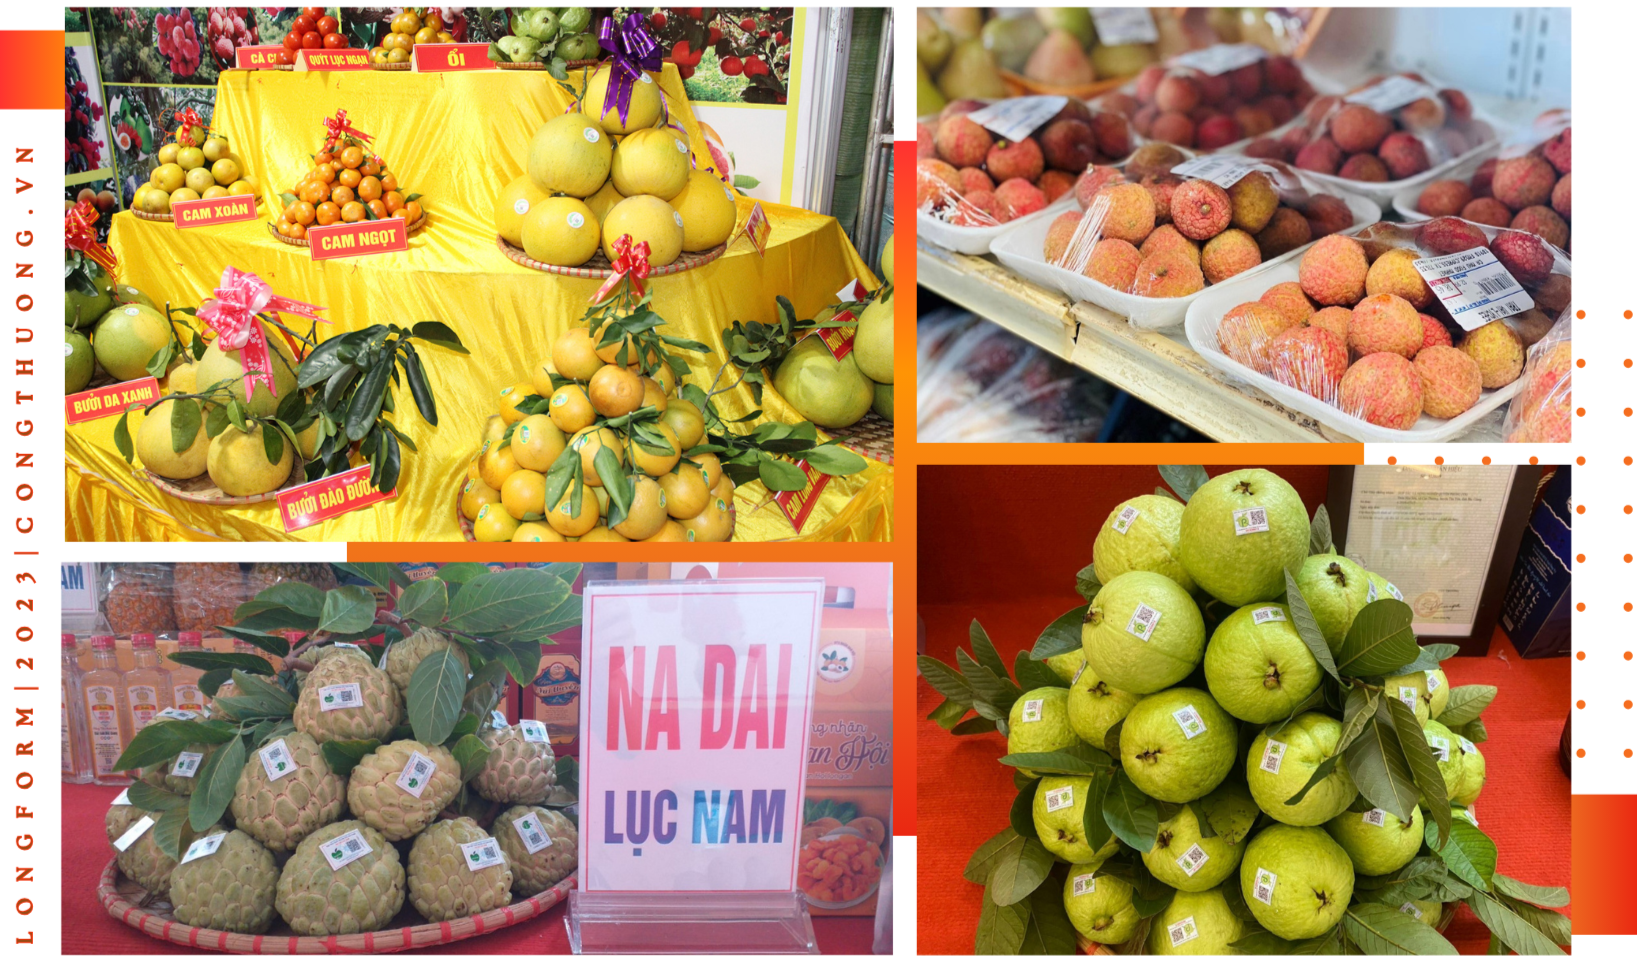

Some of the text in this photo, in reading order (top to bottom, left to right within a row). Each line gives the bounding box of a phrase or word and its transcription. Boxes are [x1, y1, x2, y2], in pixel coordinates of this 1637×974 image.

[250, 51, 265, 64] CÀ
[309, 53, 368, 68] QUÝT LỤC NGẠN
[447, 49, 465, 67] ỔI
[182, 201, 250, 222] CAM XOÀN
[321, 229, 397, 252] CAM NGỌT
[74, 386, 153, 414] BƯỞI DA XANH
[286, 491, 318, 520] BƯỞI
[319, 487, 345, 510] ĐÀO
[786, 493, 803, 520] CAM
[606, 643, 793, 751] NA DAI
[830, 720, 867, 737] nhãn
[835, 734, 891, 772] Hội
[604, 789, 678, 857] LỤC
[692, 789, 787, 844] NAM
